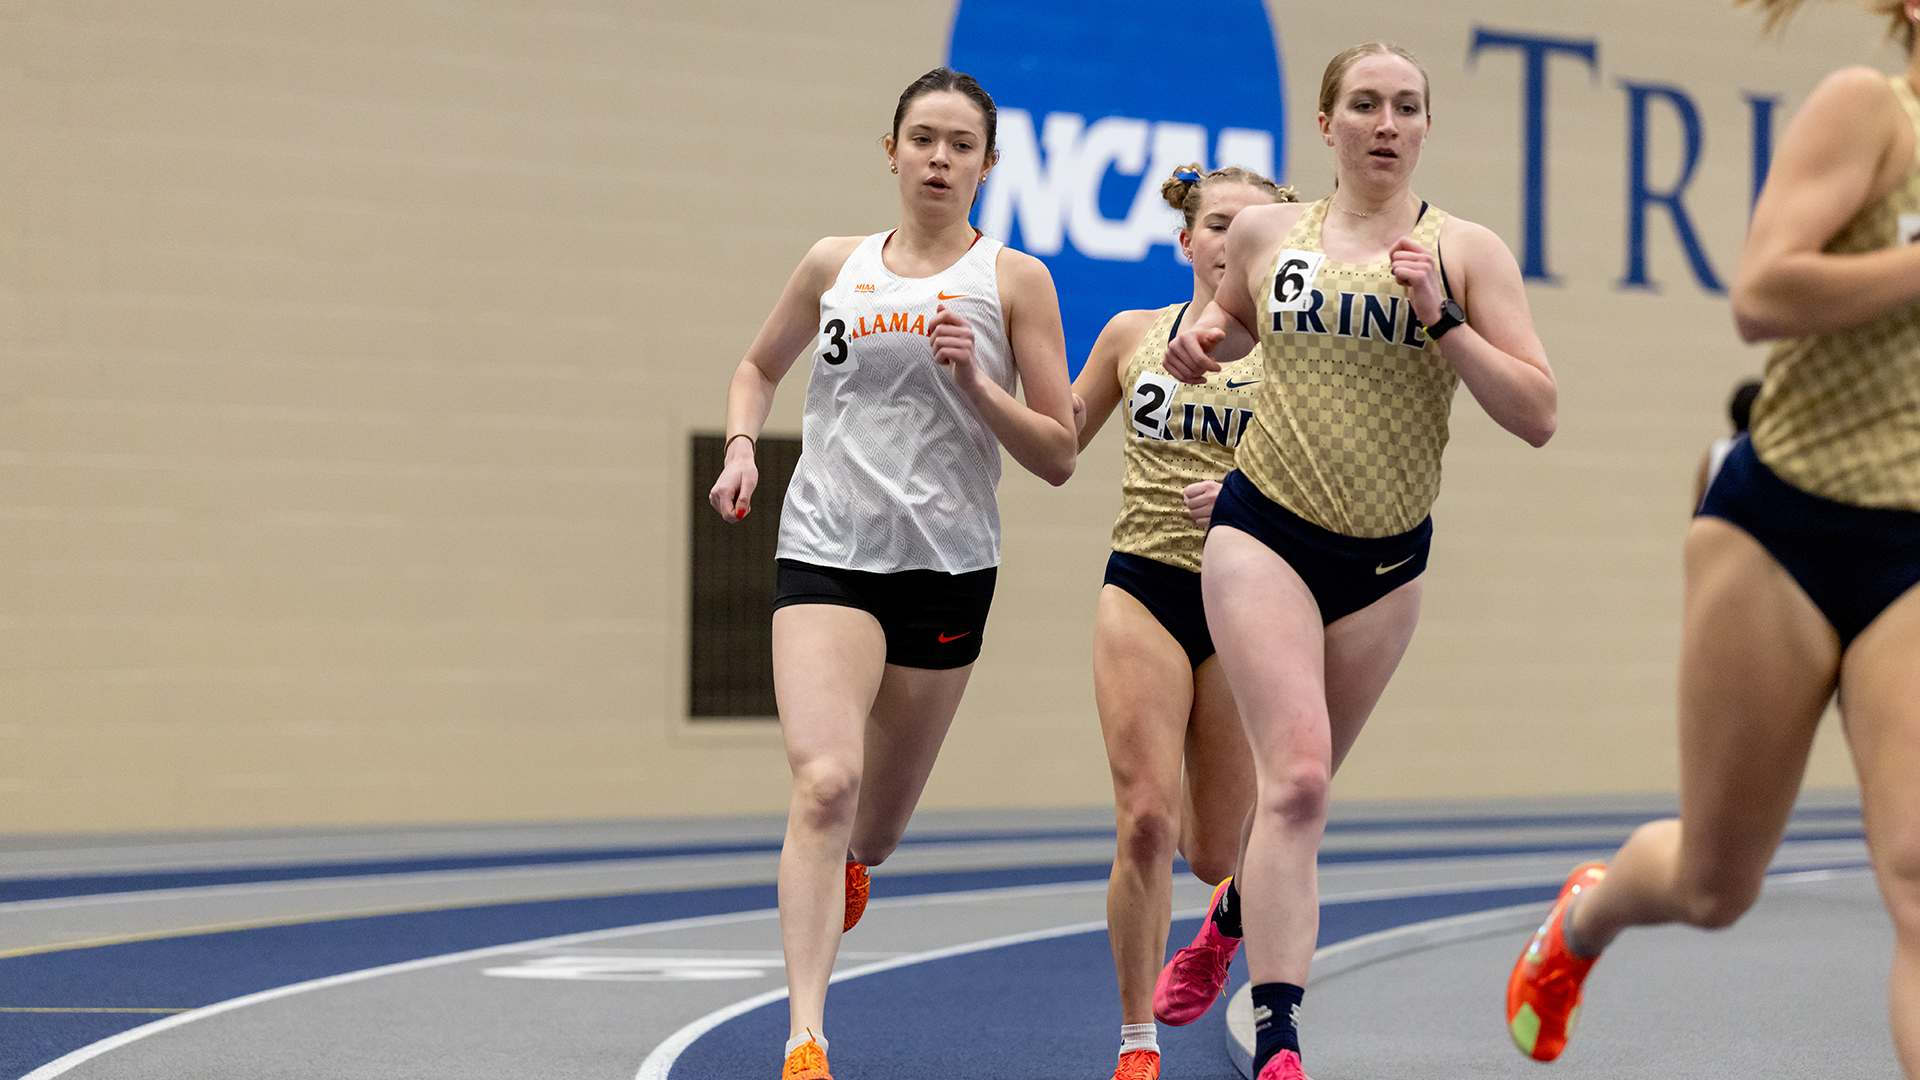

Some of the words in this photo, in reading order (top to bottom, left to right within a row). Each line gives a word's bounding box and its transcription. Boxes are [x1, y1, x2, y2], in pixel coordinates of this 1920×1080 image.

[1274, 259, 1310, 303] 6
[822, 318, 849, 366] 3
[852, 312, 931, 340] LAMA
[1134, 383, 1166, 431] 2
